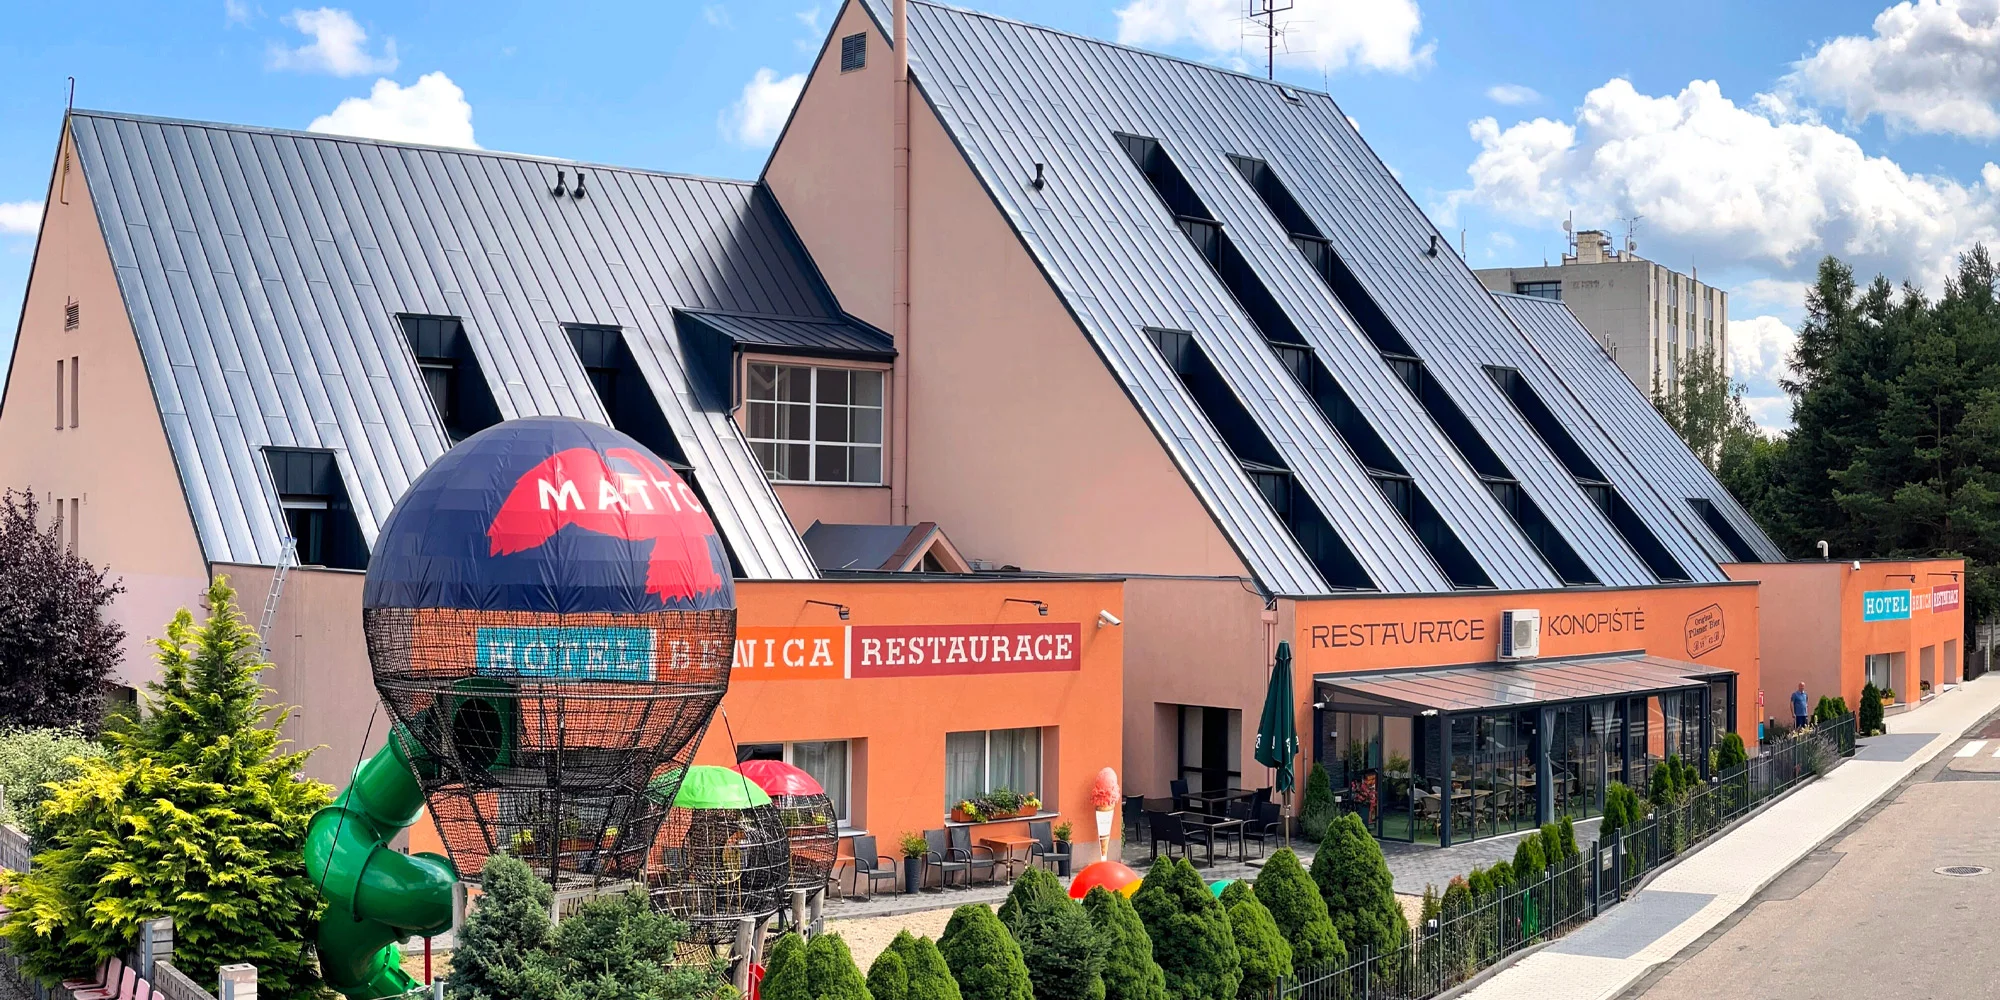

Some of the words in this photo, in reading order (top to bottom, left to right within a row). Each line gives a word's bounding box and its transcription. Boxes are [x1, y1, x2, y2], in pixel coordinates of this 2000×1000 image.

[1866, 597, 1908, 614] HOTEL
[1312, 619, 1485, 648] RESTAURACE
[1547, 607, 1645, 636] KONOPIŠTĚ
[488, 640, 642, 671] HOTEL
[669, 638, 834, 669] BENICA
[861, 634, 1073, 666] RESTAURACE
